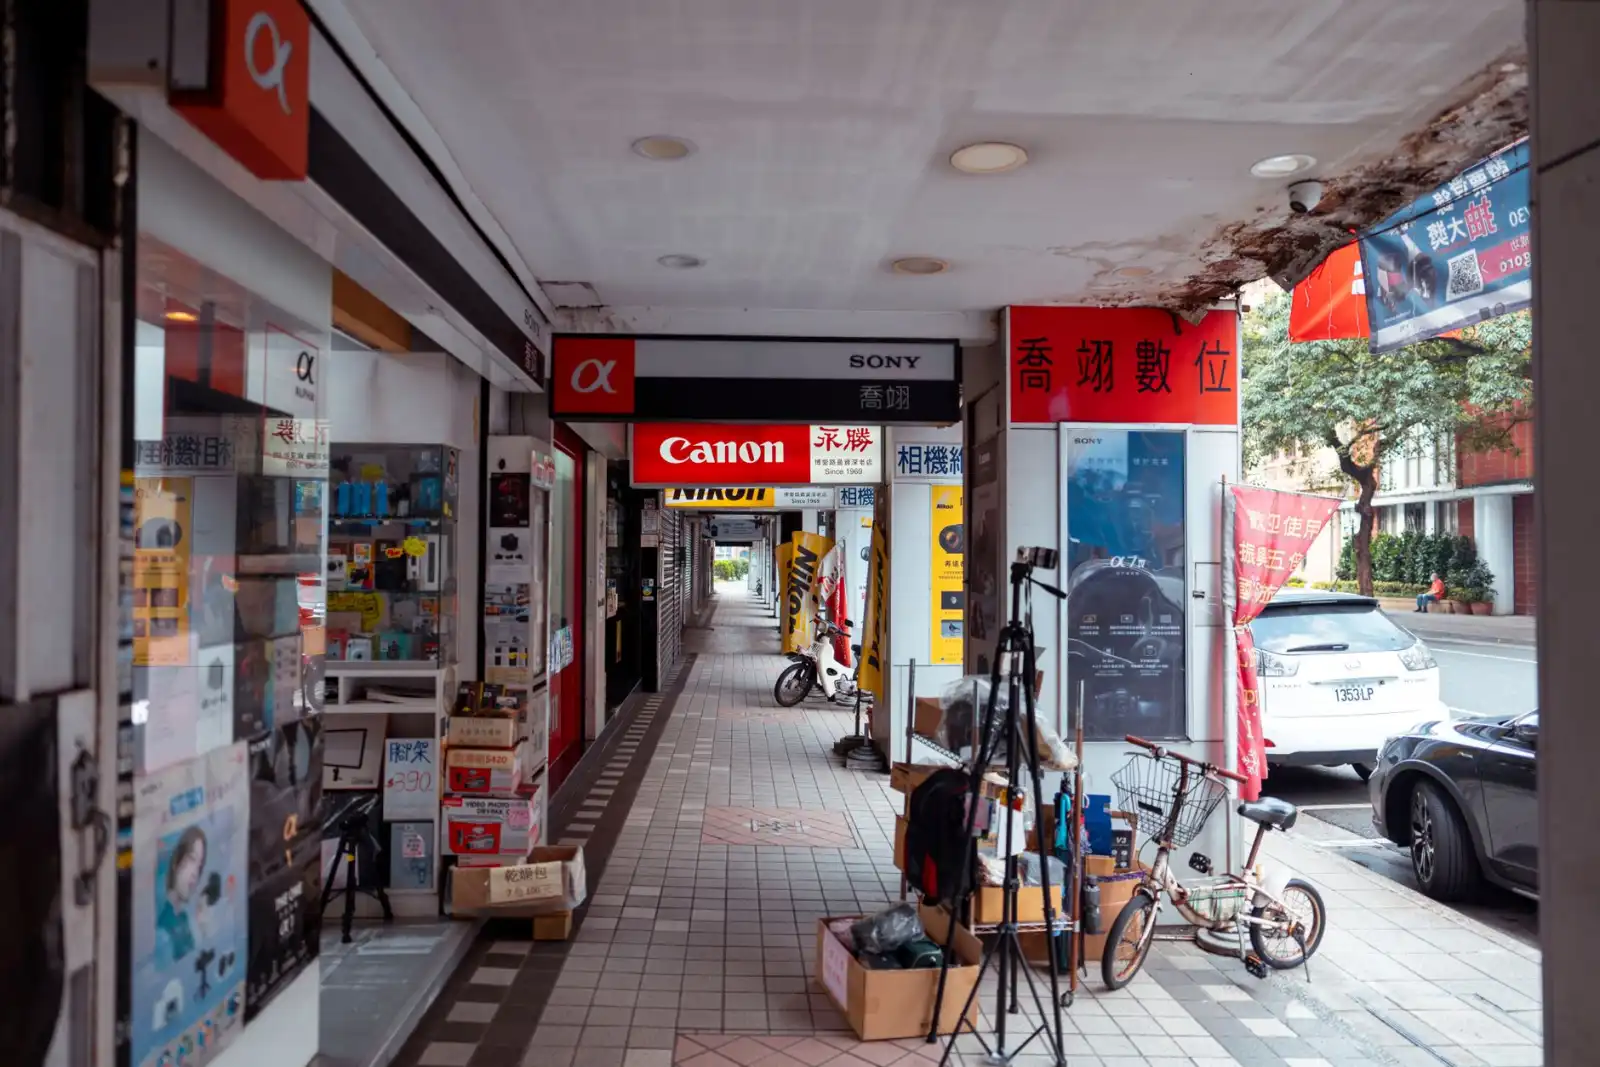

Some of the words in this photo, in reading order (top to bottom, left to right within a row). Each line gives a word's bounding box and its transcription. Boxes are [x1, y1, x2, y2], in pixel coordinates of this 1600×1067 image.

[849, 354, 921, 369] SONY
[1016, 337, 1231, 394] 喬翊數位
[859, 385, 910, 410] 喬翊
[659, 436, 784, 464] Canon
[813, 426, 873, 452] 永勝
[824, 467, 844, 475] Since
